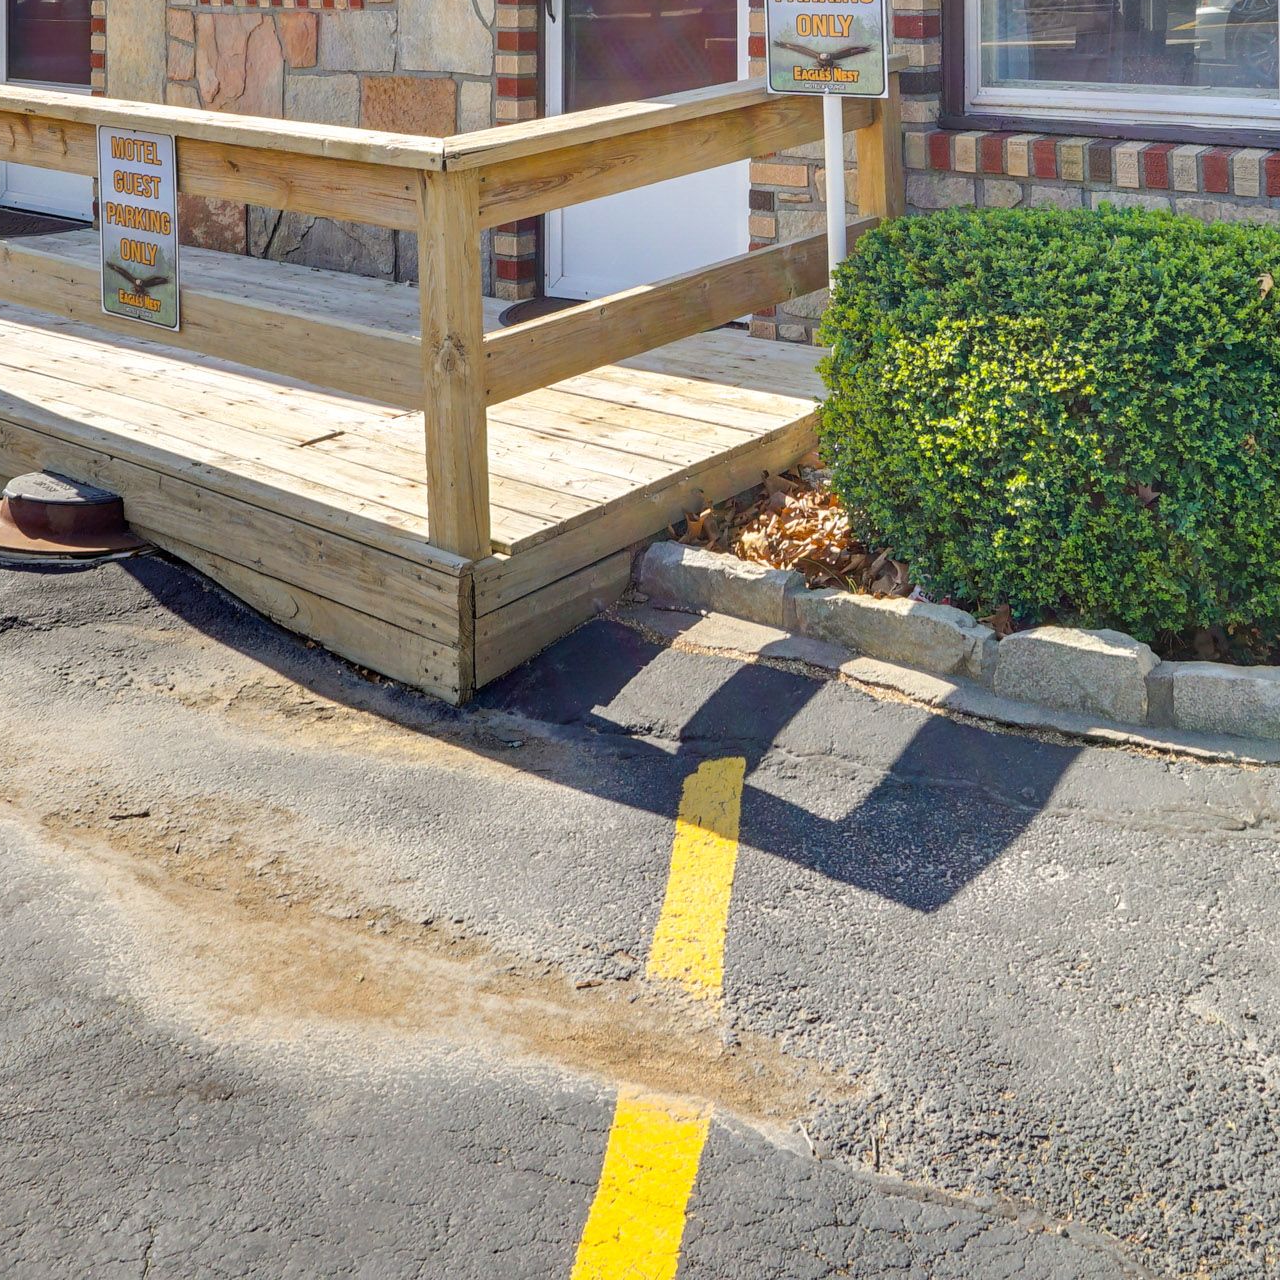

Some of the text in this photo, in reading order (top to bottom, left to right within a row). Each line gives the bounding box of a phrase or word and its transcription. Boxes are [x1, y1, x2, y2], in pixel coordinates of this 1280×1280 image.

[796, 14, 854, 38] ONLY
[833, 67, 859, 82] NEST
[111, 136, 162, 166] MOTEL
[113, 170, 161, 199] GUEST
[106, 202, 171, 235] PARKING
[120, 237, 158, 267] ONLY
